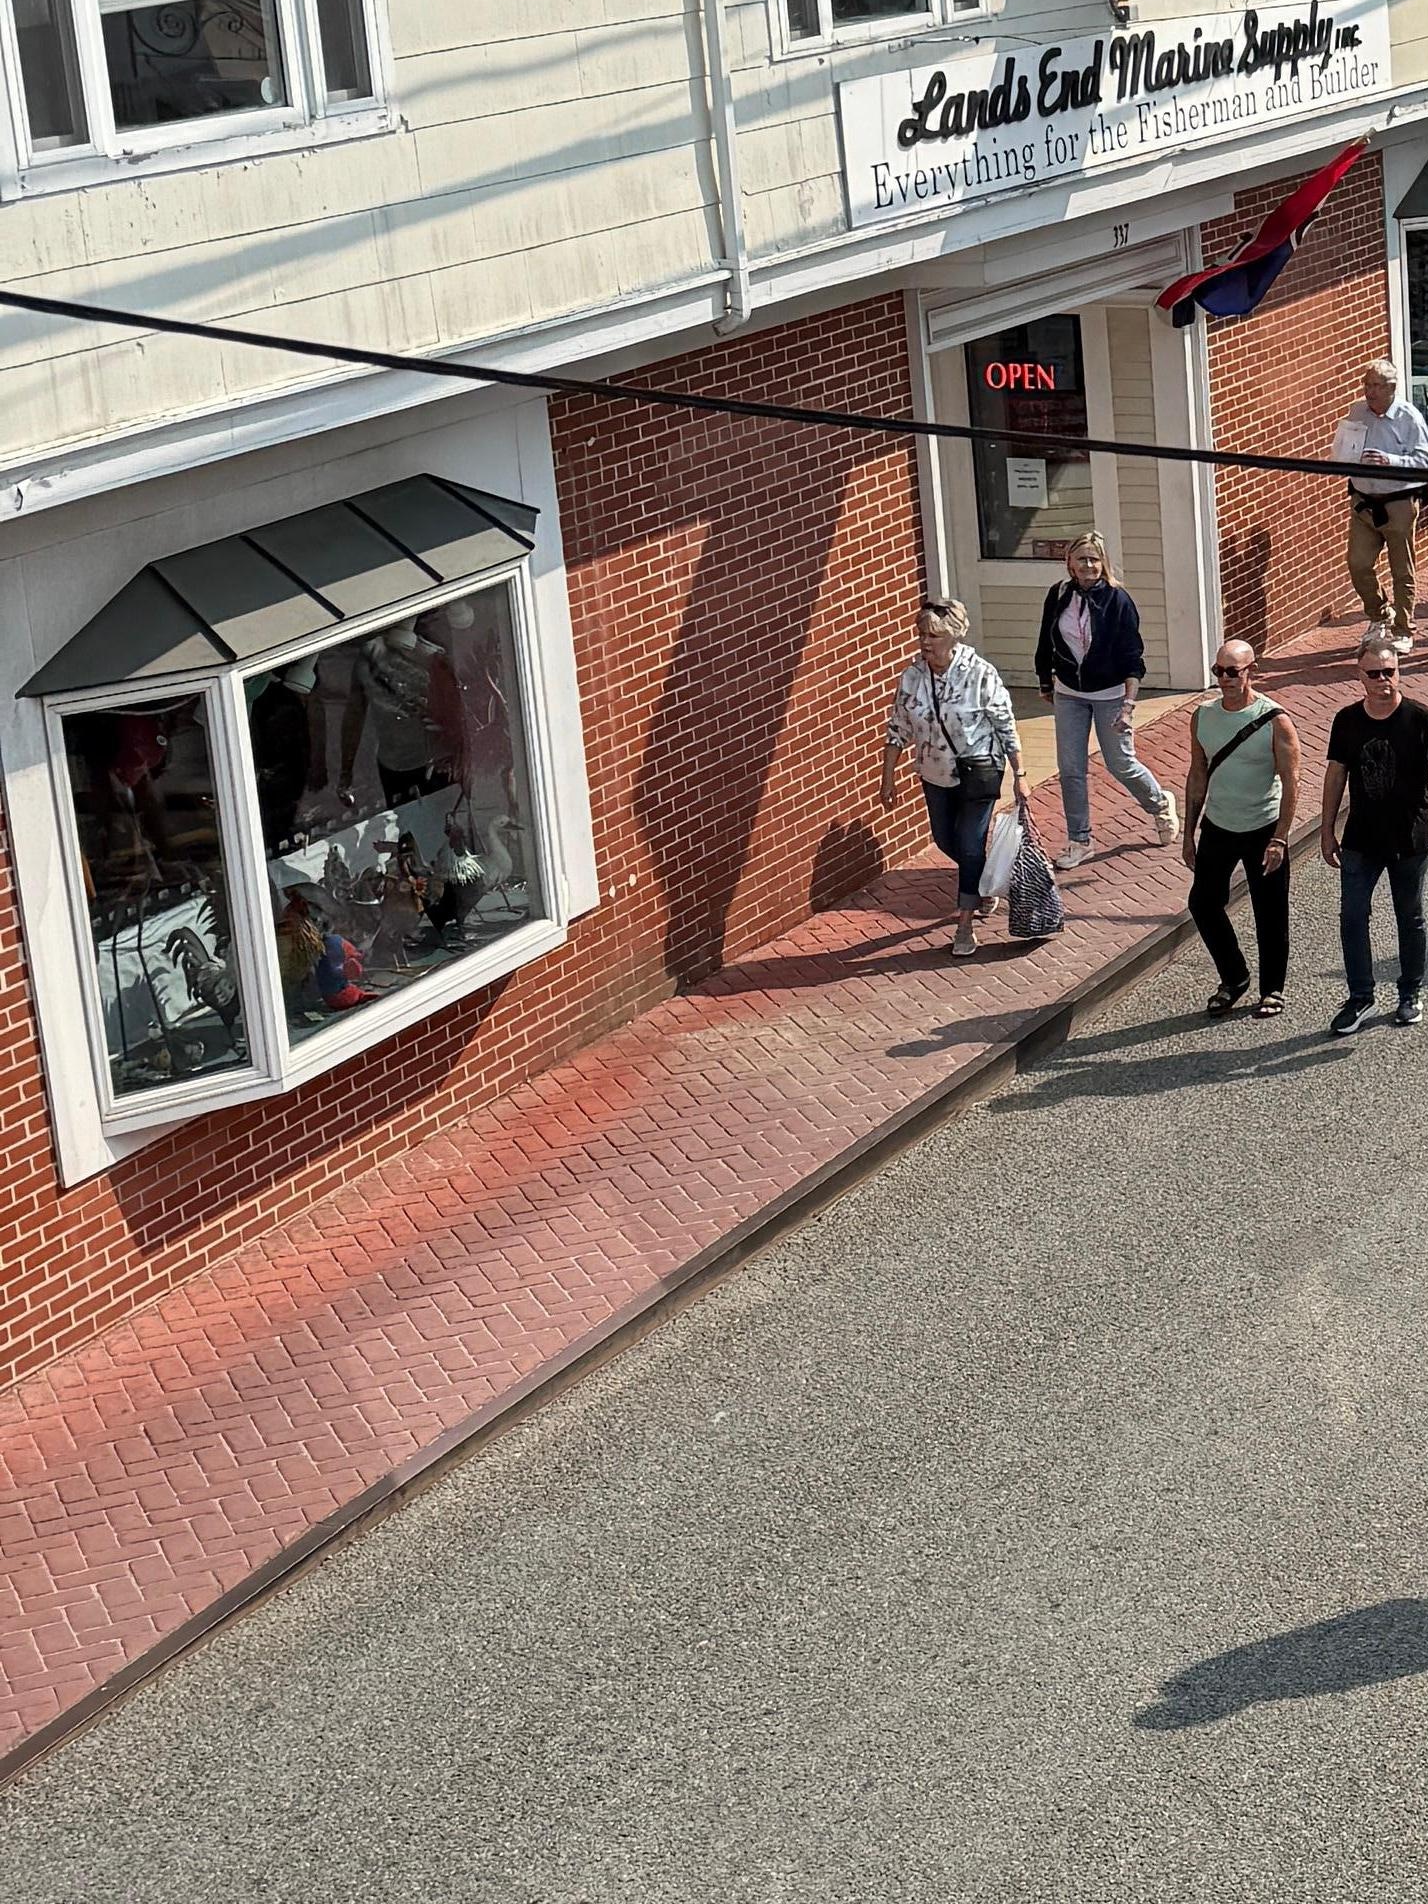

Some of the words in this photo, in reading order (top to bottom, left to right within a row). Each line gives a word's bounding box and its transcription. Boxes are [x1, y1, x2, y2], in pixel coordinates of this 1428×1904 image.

[872, 137, 1037, 211] Everything
[1045, 124, 1080, 168] for
[1088, 117, 1129, 153] the
[1136, 93, 1257, 145] Fisherman
[1265, 76, 1302, 112] and
[1309, 58, 1380, 99] Builder
[897, 55, 1031, 148] Lands
[1037, 38, 1104, 112] End
[1109, 27, 1235, 98] Marine
[1238, 0, 1334, 82] Supply
[984, 361, 1056, 391] OPEN
